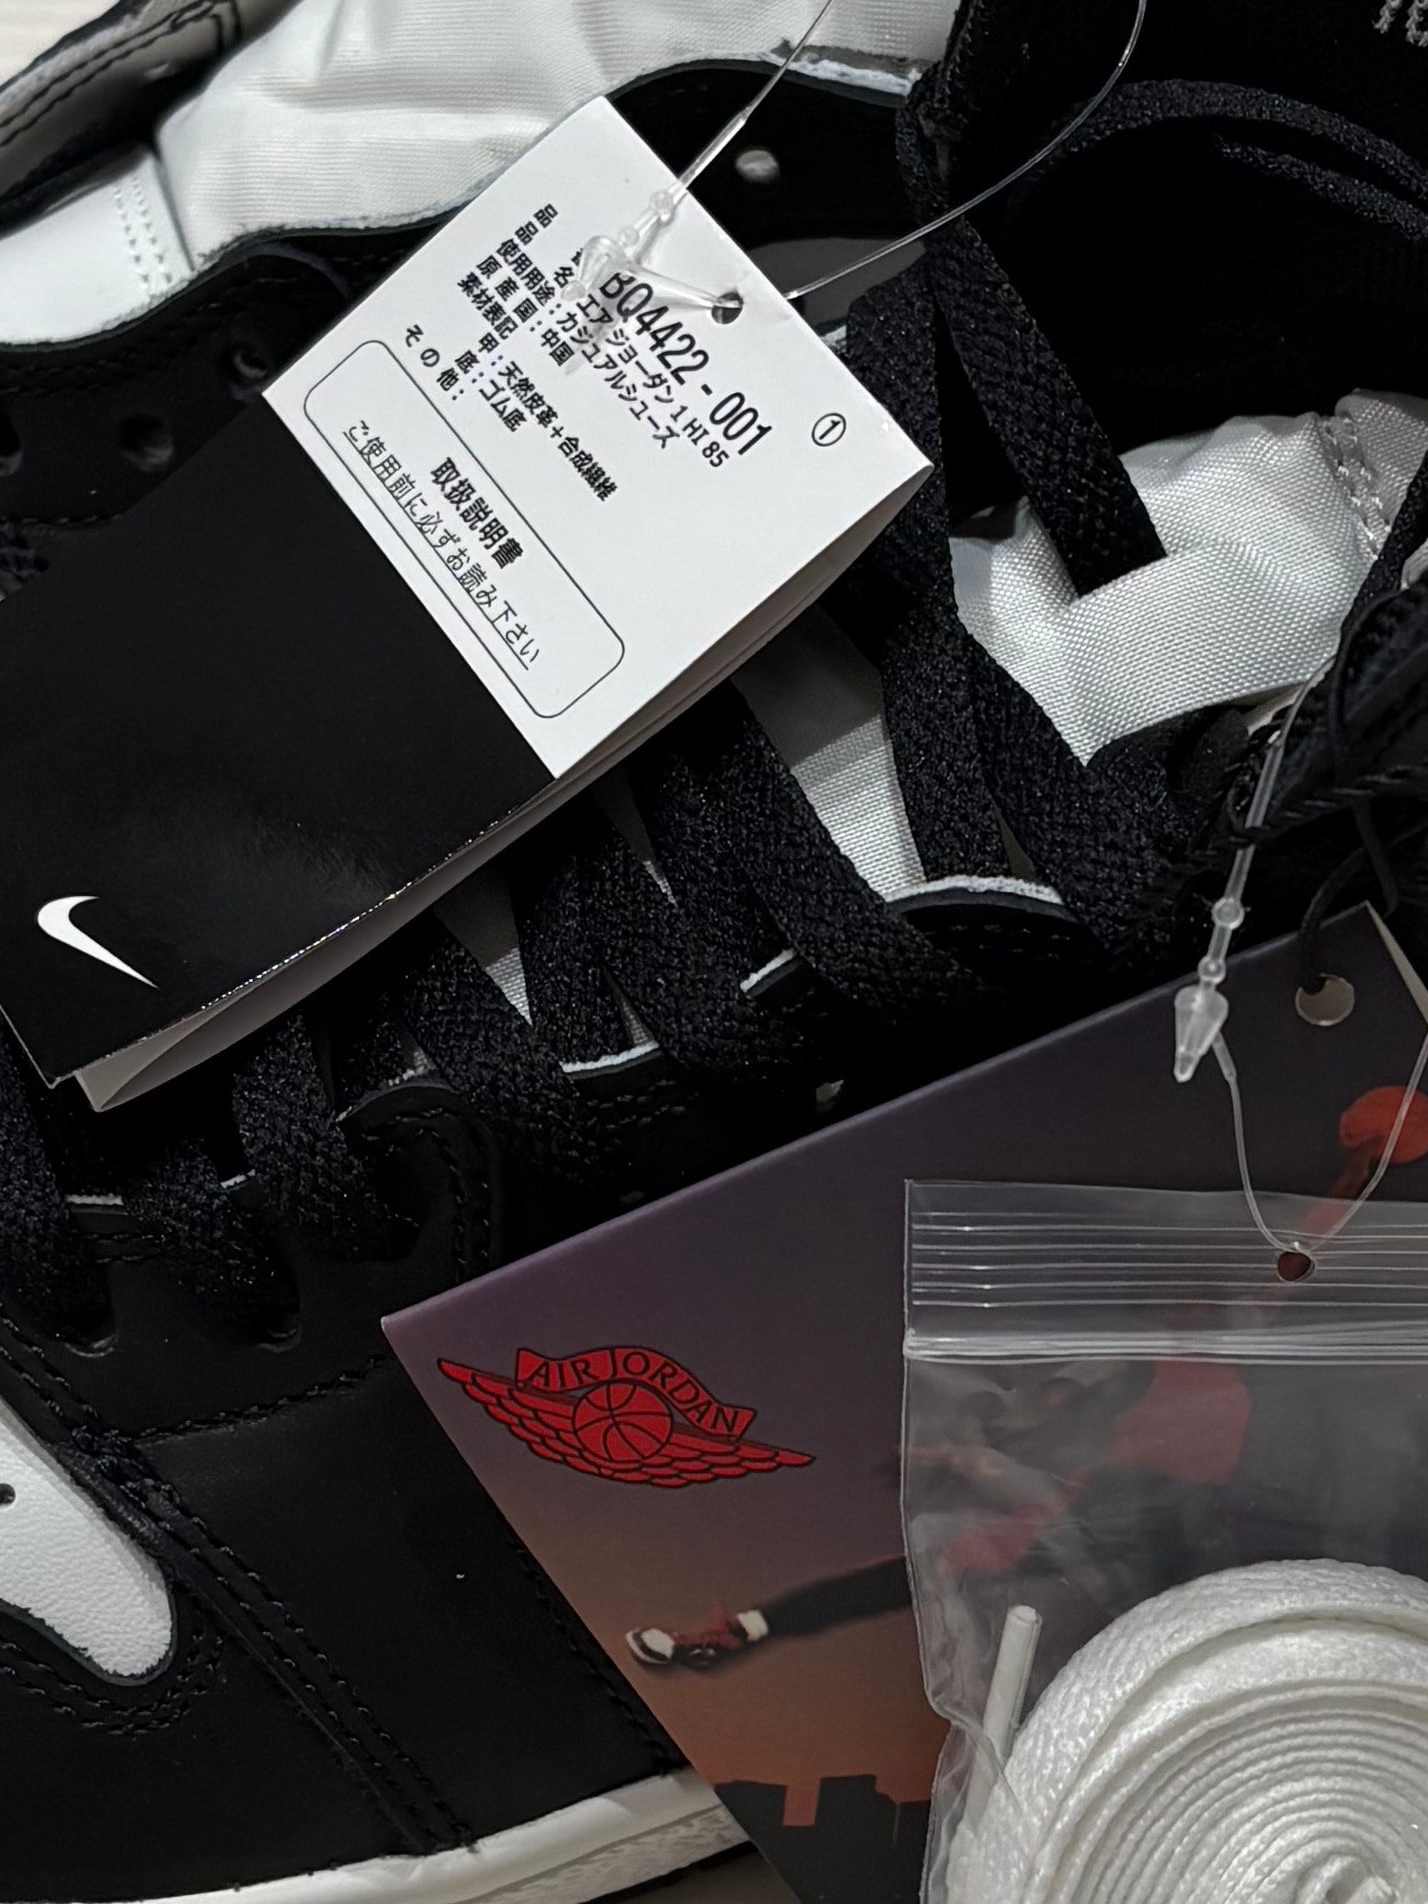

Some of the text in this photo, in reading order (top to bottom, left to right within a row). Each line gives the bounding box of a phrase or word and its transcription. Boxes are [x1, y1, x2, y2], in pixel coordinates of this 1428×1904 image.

[456, 271, 518, 340] 素材表記
[604, 328, 674, 403] ジョーダン
[669, 405, 688, 422] 1
[681, 417, 709, 446] HI
[701, 440, 729, 467] 85
[348, 419, 539, 662] ご使用前に必ずお読み下さい
[430, 456, 523, 569] 取扱説明書
[529, 1347, 740, 1434] AIR JORDAN
